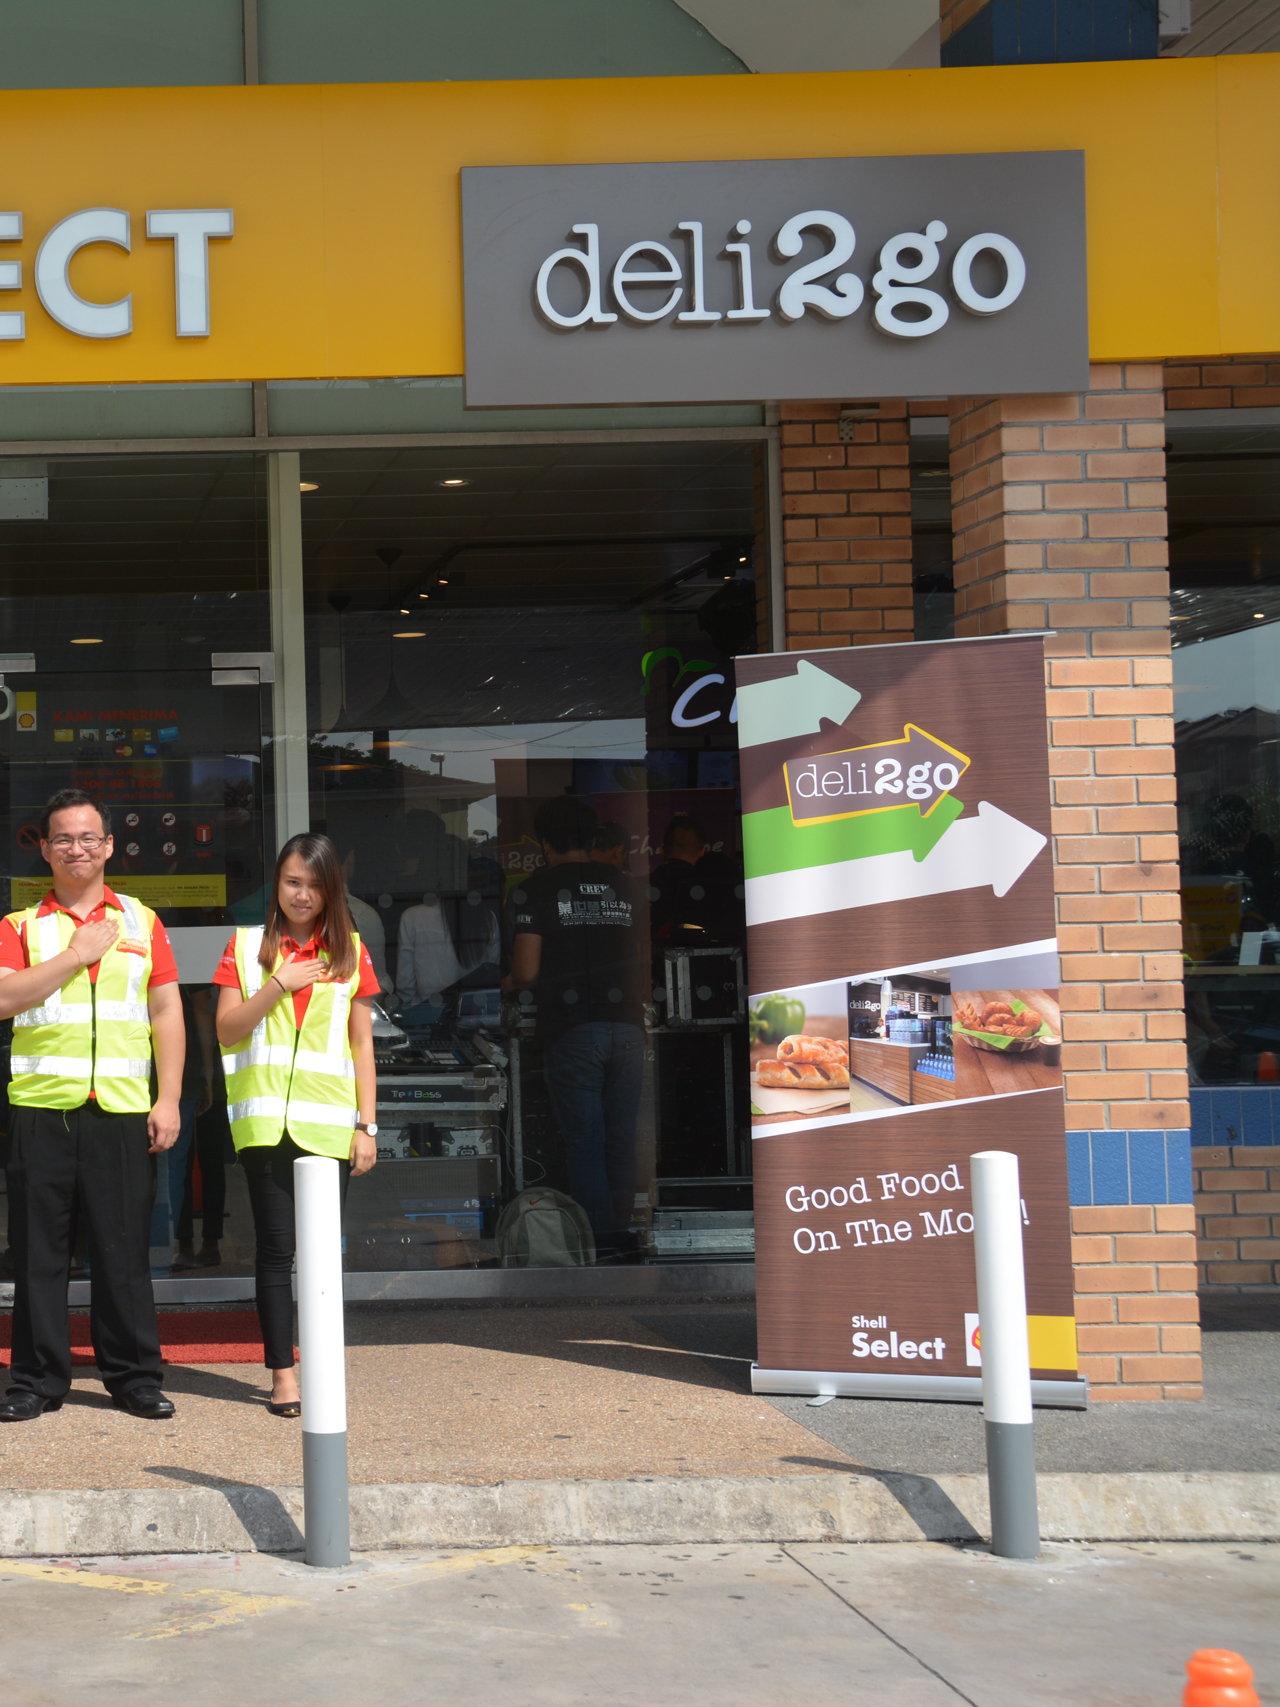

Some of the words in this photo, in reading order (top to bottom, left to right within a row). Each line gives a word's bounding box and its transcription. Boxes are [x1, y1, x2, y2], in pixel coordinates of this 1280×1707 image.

[535, 209, 1026, 339] deli2go
[53, 710, 94, 722] KAMI
[98, 709, 179, 721] MENERIMA
[795, 758, 959, 800] deli2go
[849, 1000, 881, 1012] deli2go
[785, 1177, 872, 1213] Good
[877, 1164, 964, 1200] Food
[793, 1227, 841, 1255] On
[846, 1219, 912, 1248] The
[919, 1199, 1030, 1240] Mo!
[851, 1315, 887, 1329] Shell
[851, 1331, 946, 1361] Select
